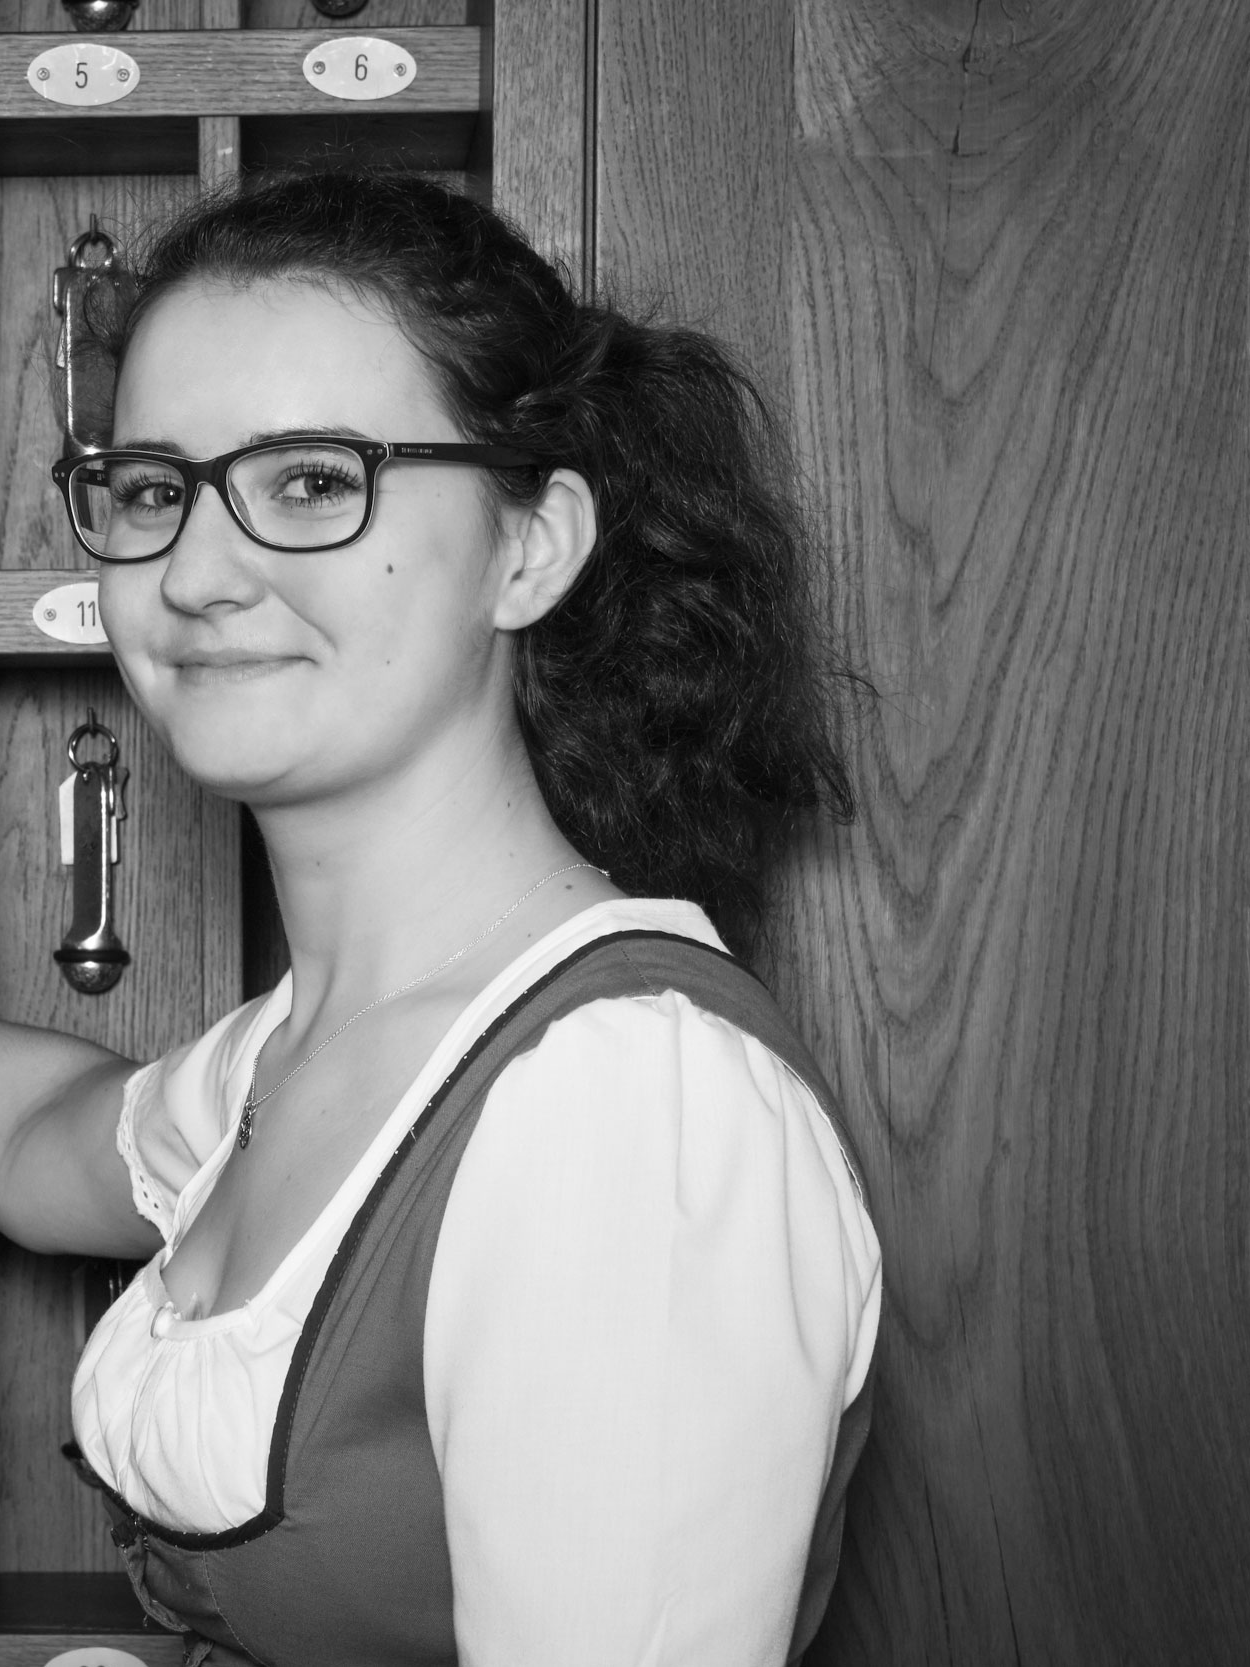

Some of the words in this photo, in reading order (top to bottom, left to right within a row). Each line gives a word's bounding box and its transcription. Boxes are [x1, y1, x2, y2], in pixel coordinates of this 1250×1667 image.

[74, 61, 89, 89] 5
[354, 53, 368, 82] 6
[76, 600, 97, 627] 11
